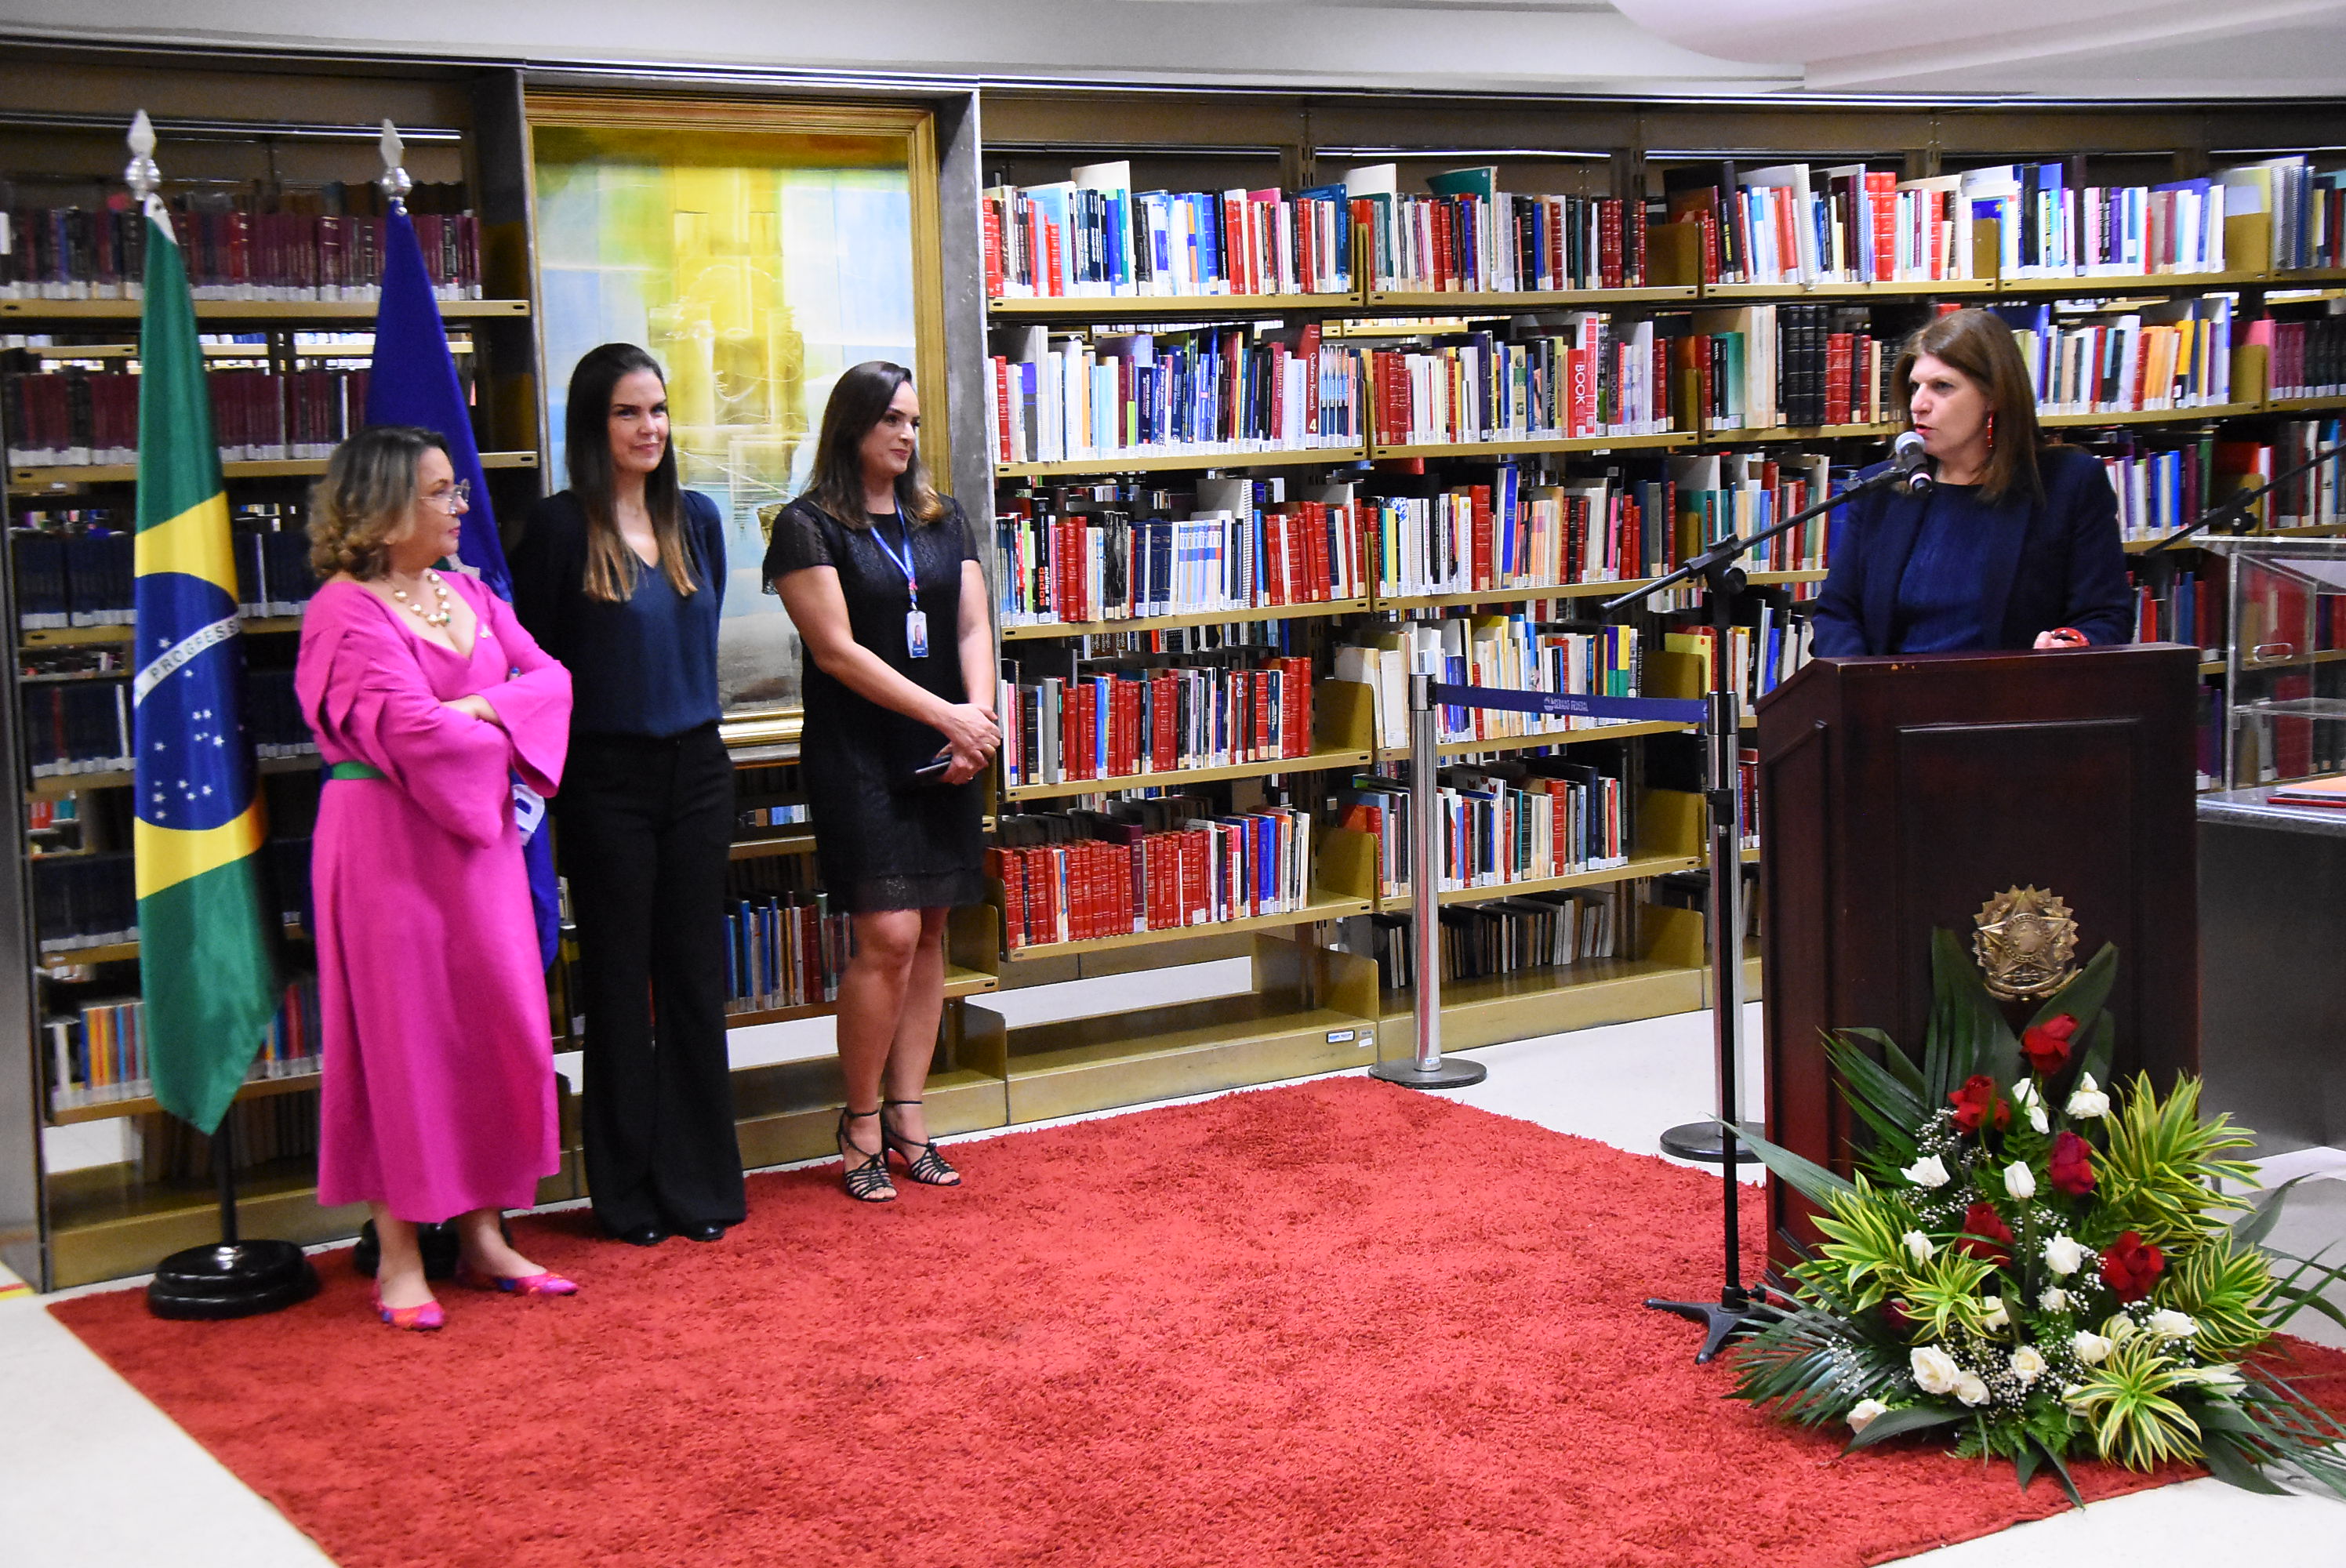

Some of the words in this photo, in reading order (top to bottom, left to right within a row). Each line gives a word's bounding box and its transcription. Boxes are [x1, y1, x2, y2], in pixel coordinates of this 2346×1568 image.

[1575, 365, 1585, 405] BOOK
[1309, 418, 1317, 432] 4
[1045, 597, 1051, 606] de
